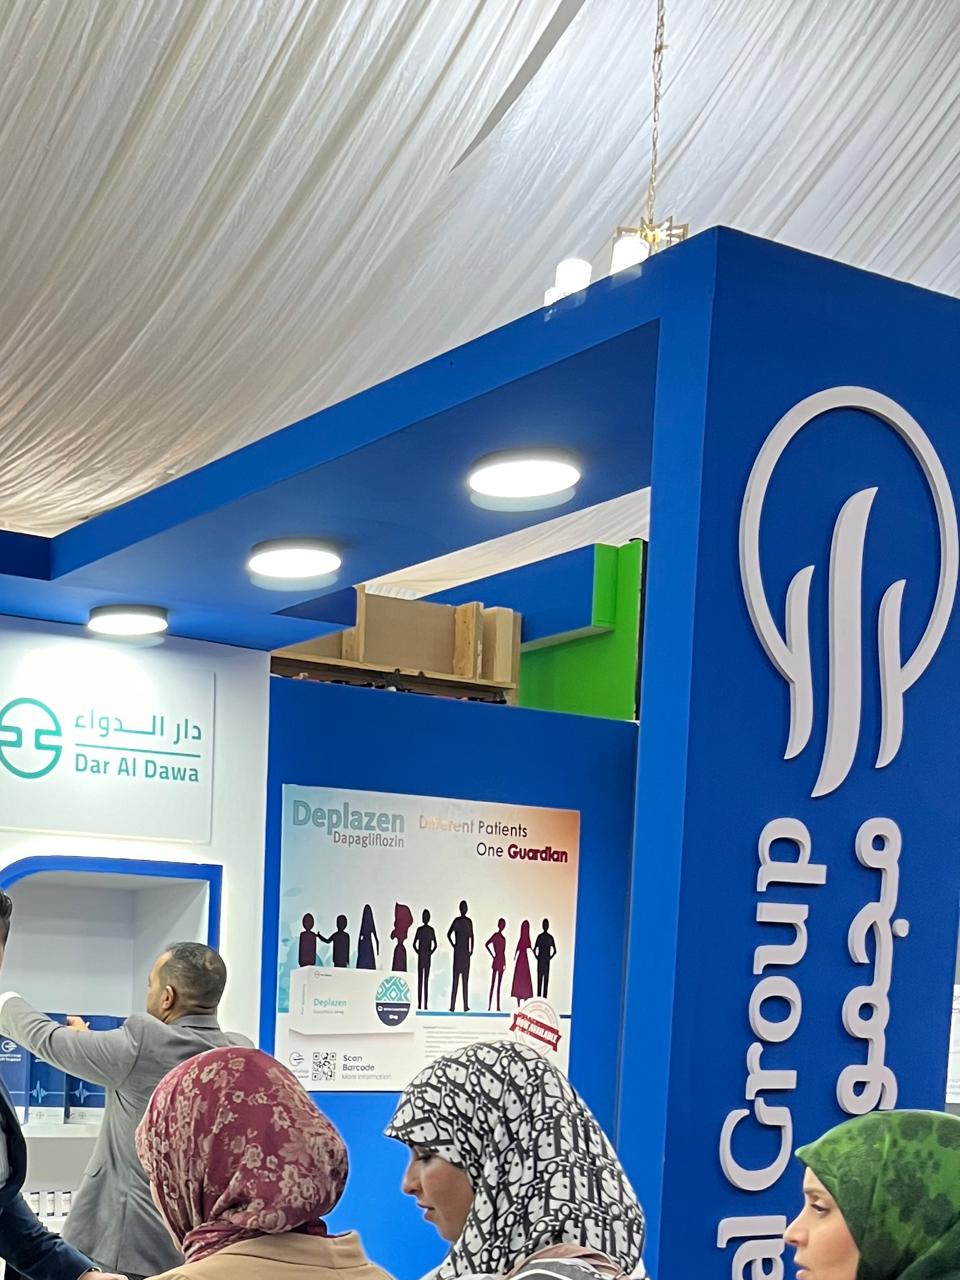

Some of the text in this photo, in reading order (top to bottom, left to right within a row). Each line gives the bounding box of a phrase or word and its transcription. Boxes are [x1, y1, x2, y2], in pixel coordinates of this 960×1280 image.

[173, 717, 202, 745] دار
[74, 752, 200, 783] Dar Al Dawa
[292, 799, 406, 836] Deplazen
[418, 814, 529, 838] Different Patients
[332, 830, 405, 849] Dapagliflozin
[476, 842, 569, 863] One Guardian
[836, 816, 910, 1116] مجمو
[719, 816, 828, 1192] Group
[342, 1063, 375, 1072] Barcode
[343, 1054, 363, 1062] Scan
